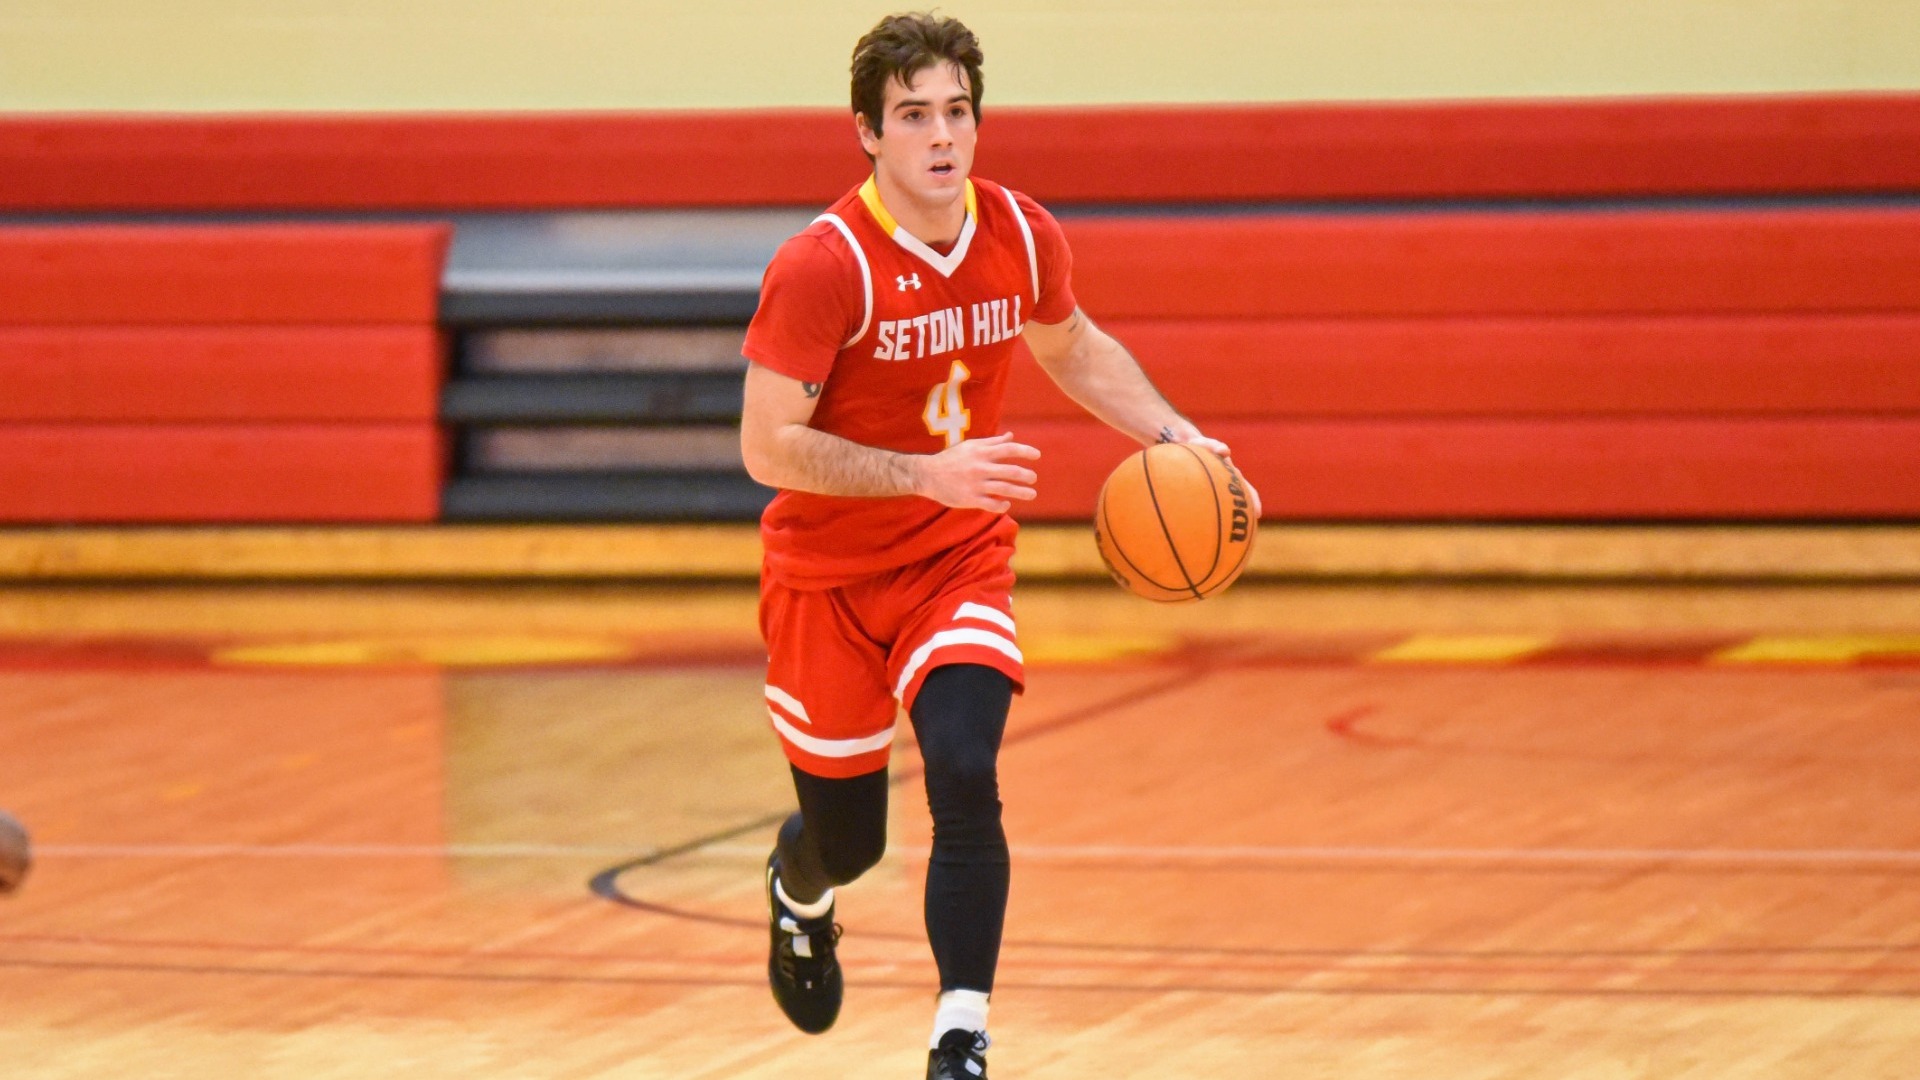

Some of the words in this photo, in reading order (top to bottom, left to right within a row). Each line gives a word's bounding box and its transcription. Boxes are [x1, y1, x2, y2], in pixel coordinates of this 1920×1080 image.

[873, 306, 965, 361] SETON
[972, 294, 1024, 347] HILL
[922, 359, 971, 449] 4
[1217, 456, 1249, 543] Wil
